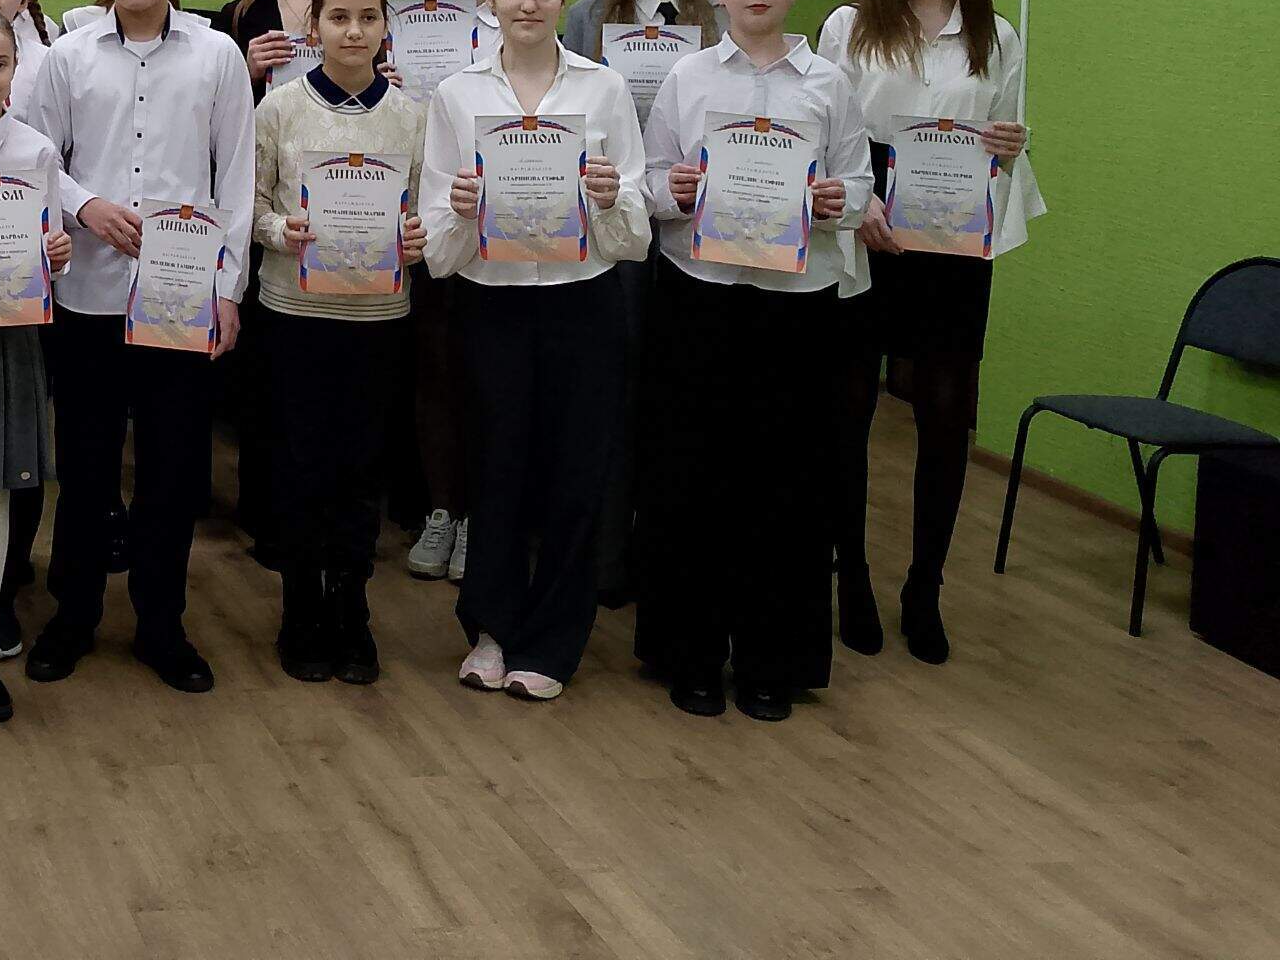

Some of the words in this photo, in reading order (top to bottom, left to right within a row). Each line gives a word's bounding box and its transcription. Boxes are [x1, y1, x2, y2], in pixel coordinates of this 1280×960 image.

[405, 13, 457, 25] ДИПЛОМ
[623, 41, 679, 53] ДИПЛОМ
[498, 133, 562, 146] ДИПЛОМ
[727, 132, 793, 150] ДИПЛОМ
[913, 132, 976, 146] ДИПЛОМ
[325, 168, 386, 181] ДИПЛОМ
[156, 219, 209, 236] ДИПЛОМ
